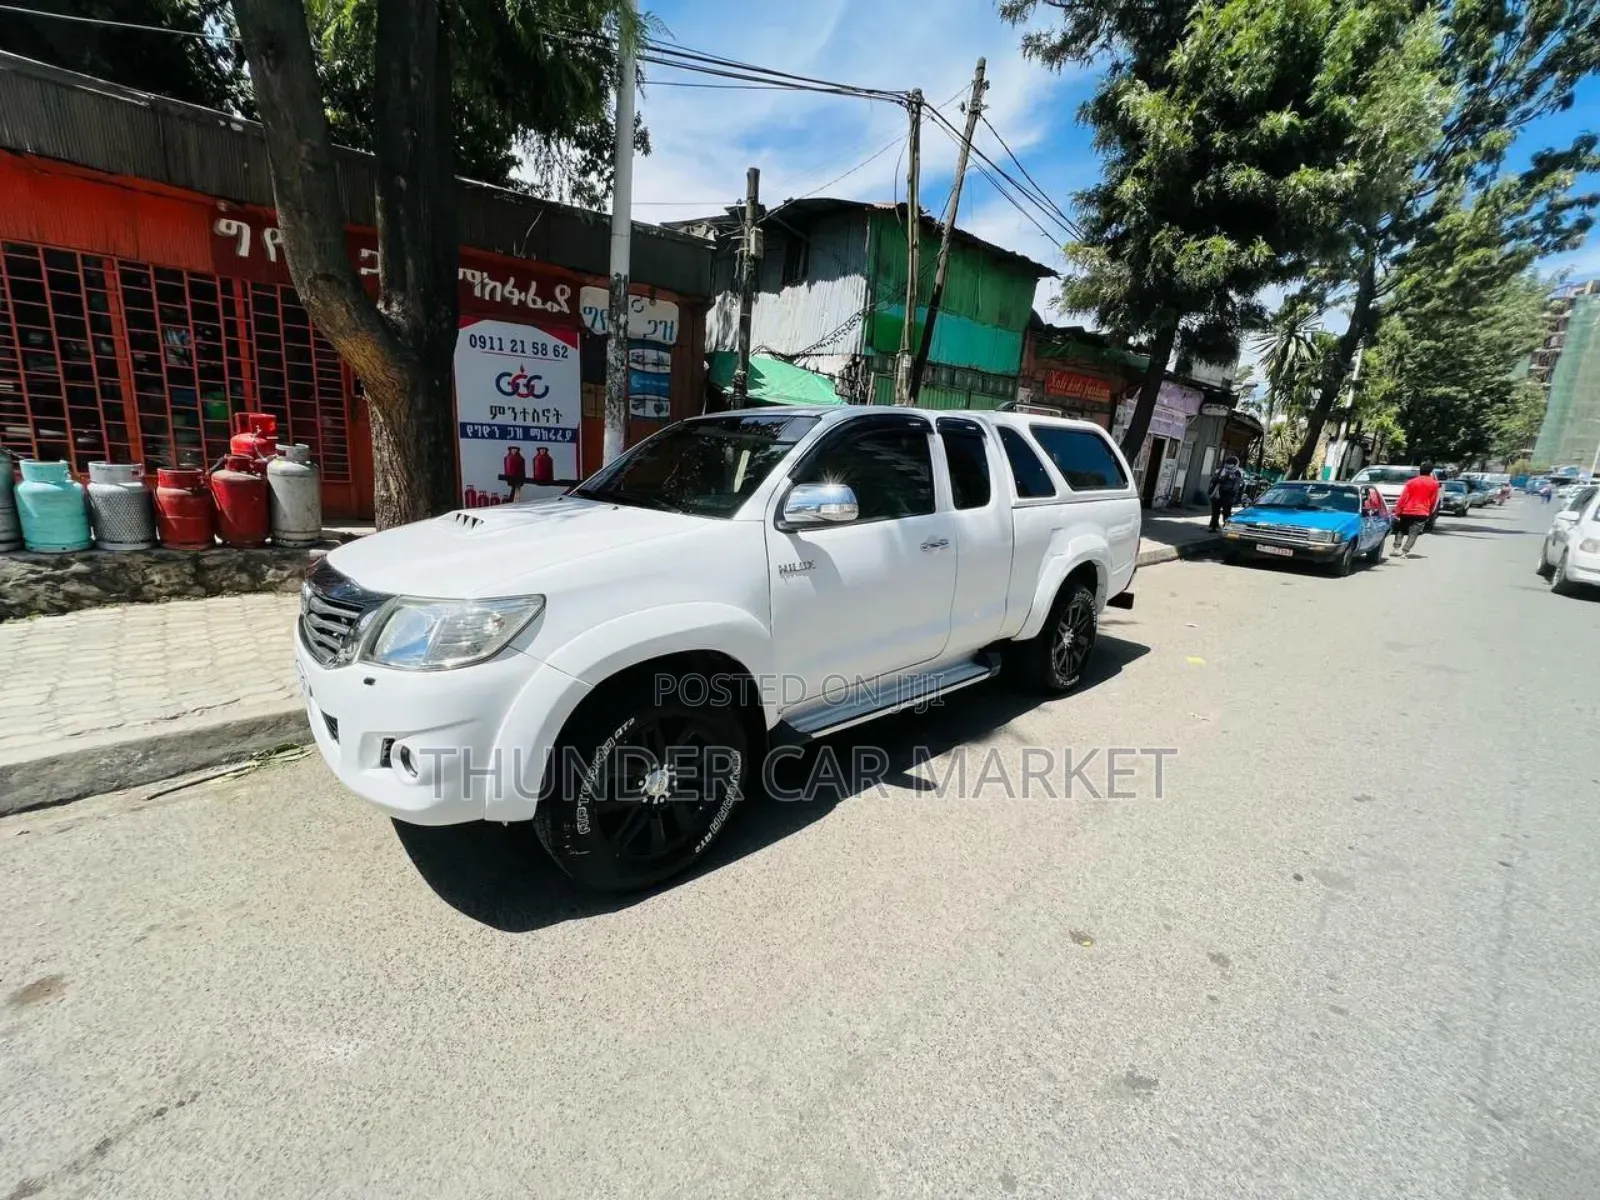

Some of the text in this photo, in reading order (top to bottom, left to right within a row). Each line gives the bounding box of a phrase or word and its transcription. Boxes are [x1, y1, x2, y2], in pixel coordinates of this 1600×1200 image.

[469, 333, 569, 359] 0911 21 58 62
